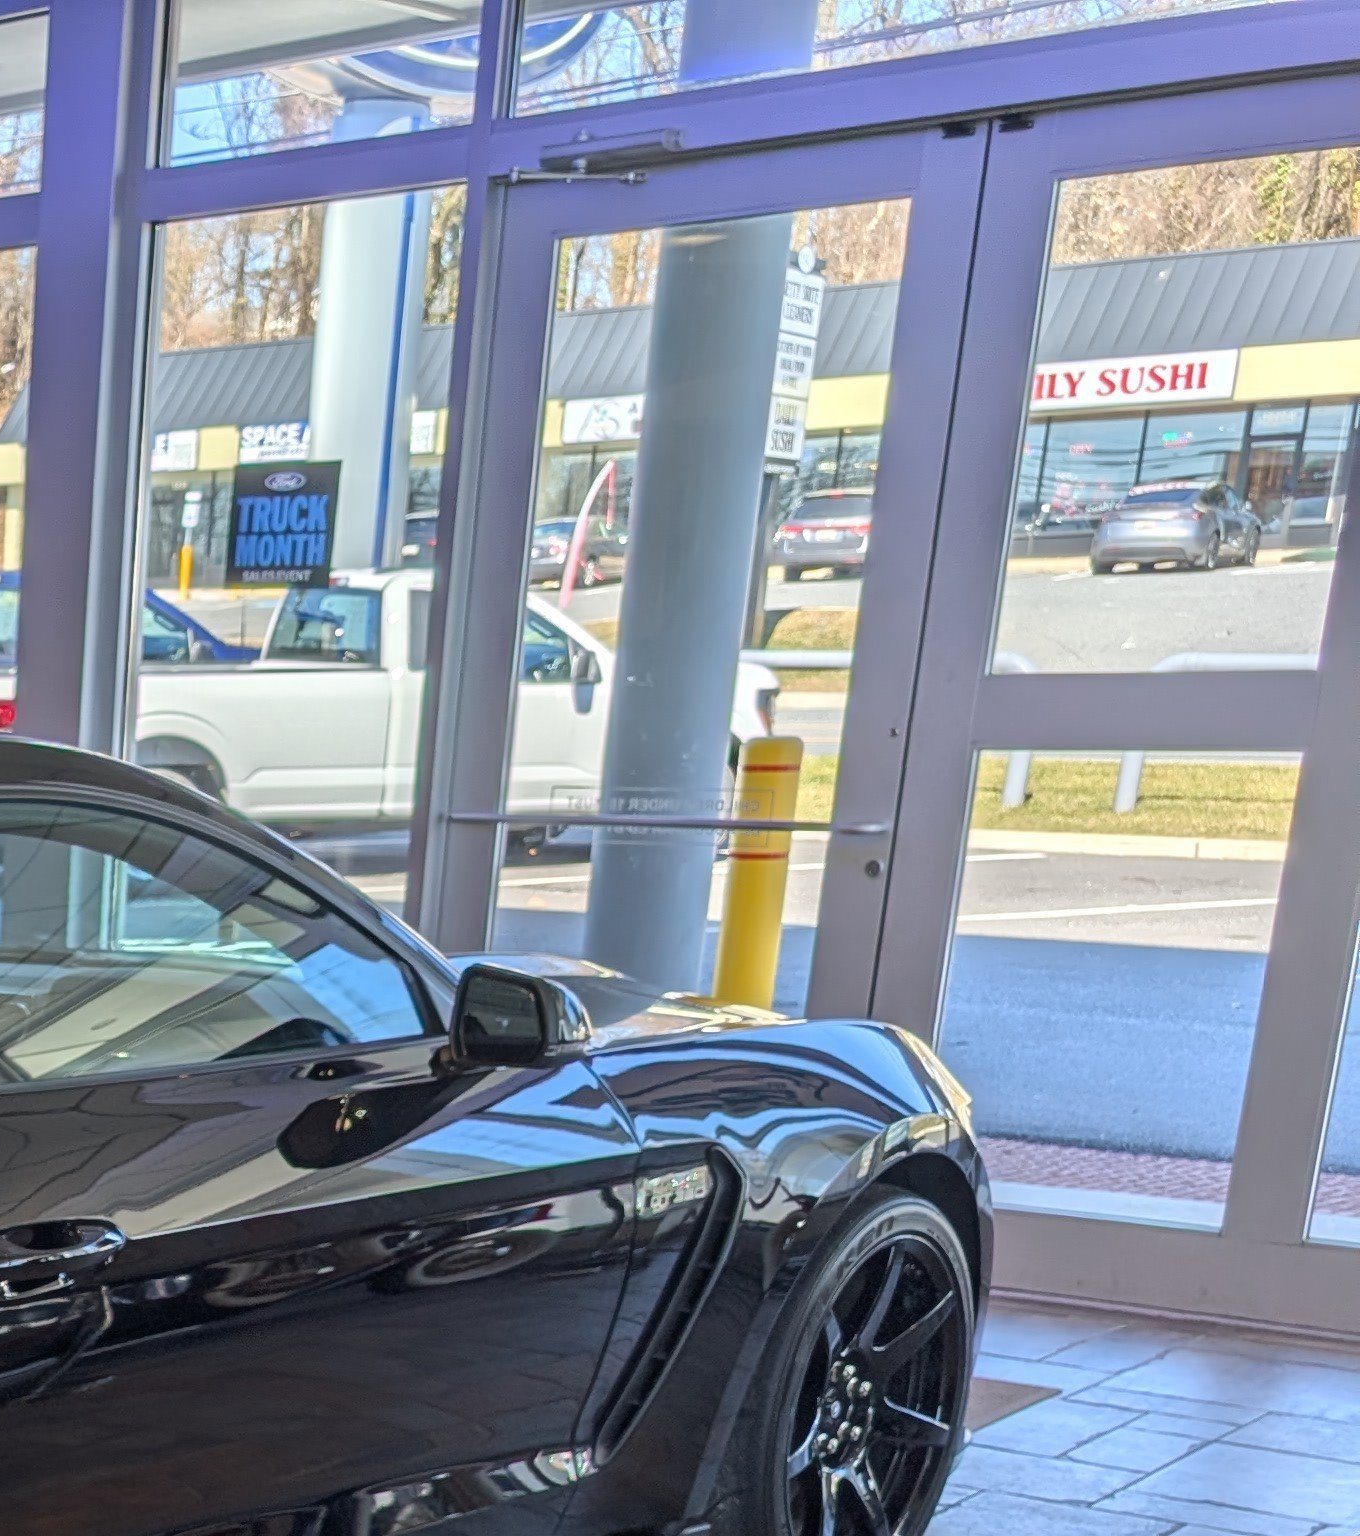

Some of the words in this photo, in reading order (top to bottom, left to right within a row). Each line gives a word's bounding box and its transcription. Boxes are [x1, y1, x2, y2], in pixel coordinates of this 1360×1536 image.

[1034, 371, 1085, 400] ILY
[1096, 362, 1208, 397] SUSHI
[241, 423, 300, 447] SPACE
[236, 494, 328, 533] TRUCK
[234, 533, 327, 568] MONTH
[242, 570, 275, 582] SALES
[276, 569, 312, 582] EVENT
